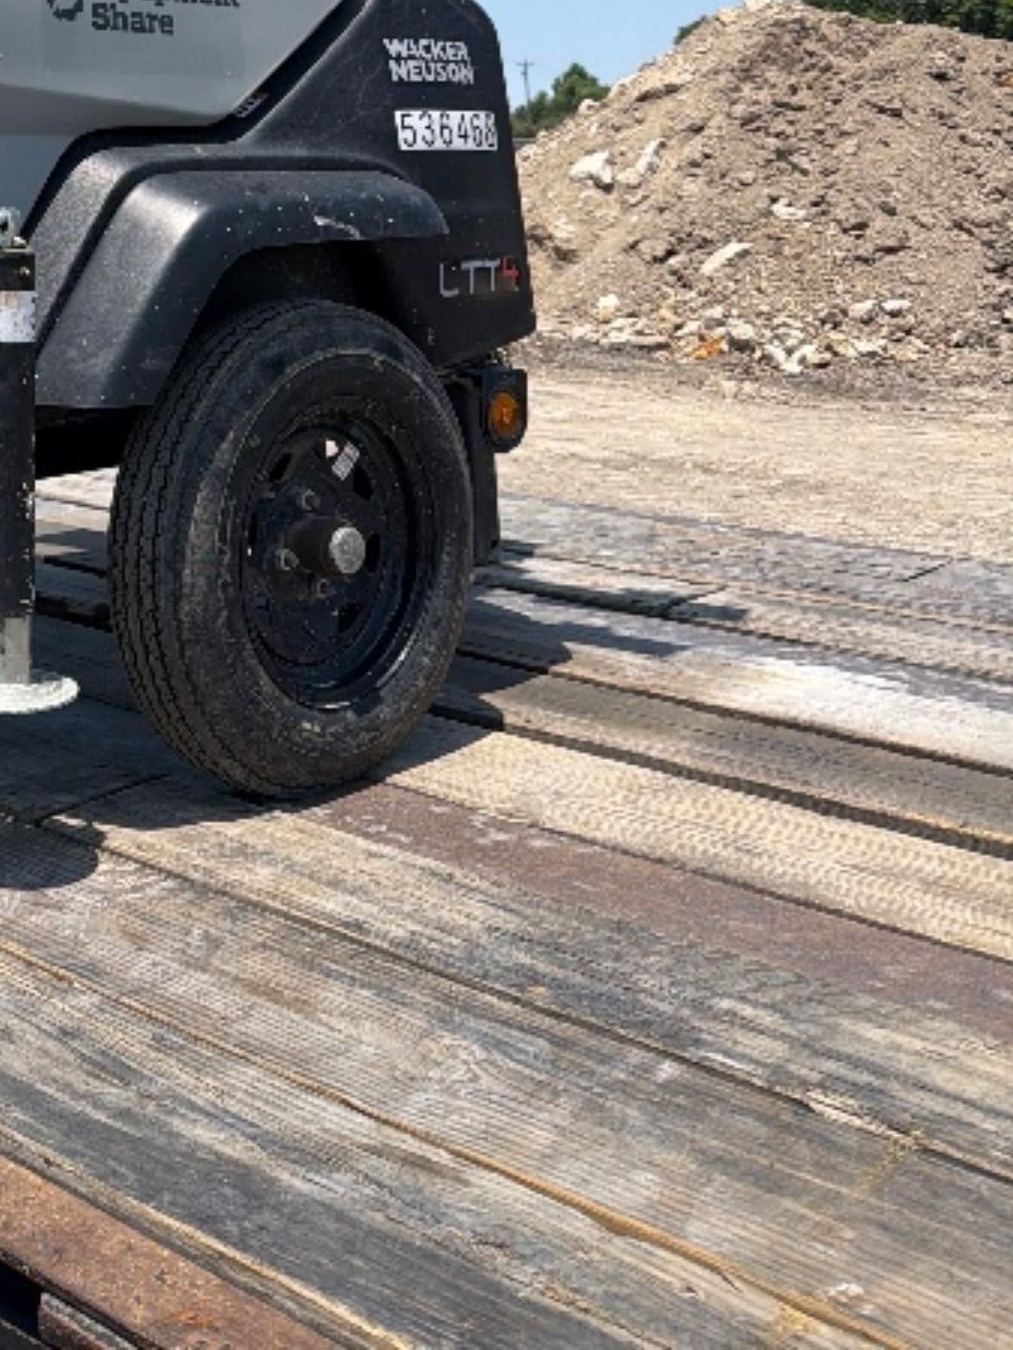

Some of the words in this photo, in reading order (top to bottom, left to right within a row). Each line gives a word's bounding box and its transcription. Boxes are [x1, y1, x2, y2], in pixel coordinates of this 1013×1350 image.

[91, 2, 175, 36] Share
[383, 38, 470, 61] WACKER
[388, 59, 475, 85] NEUSON
